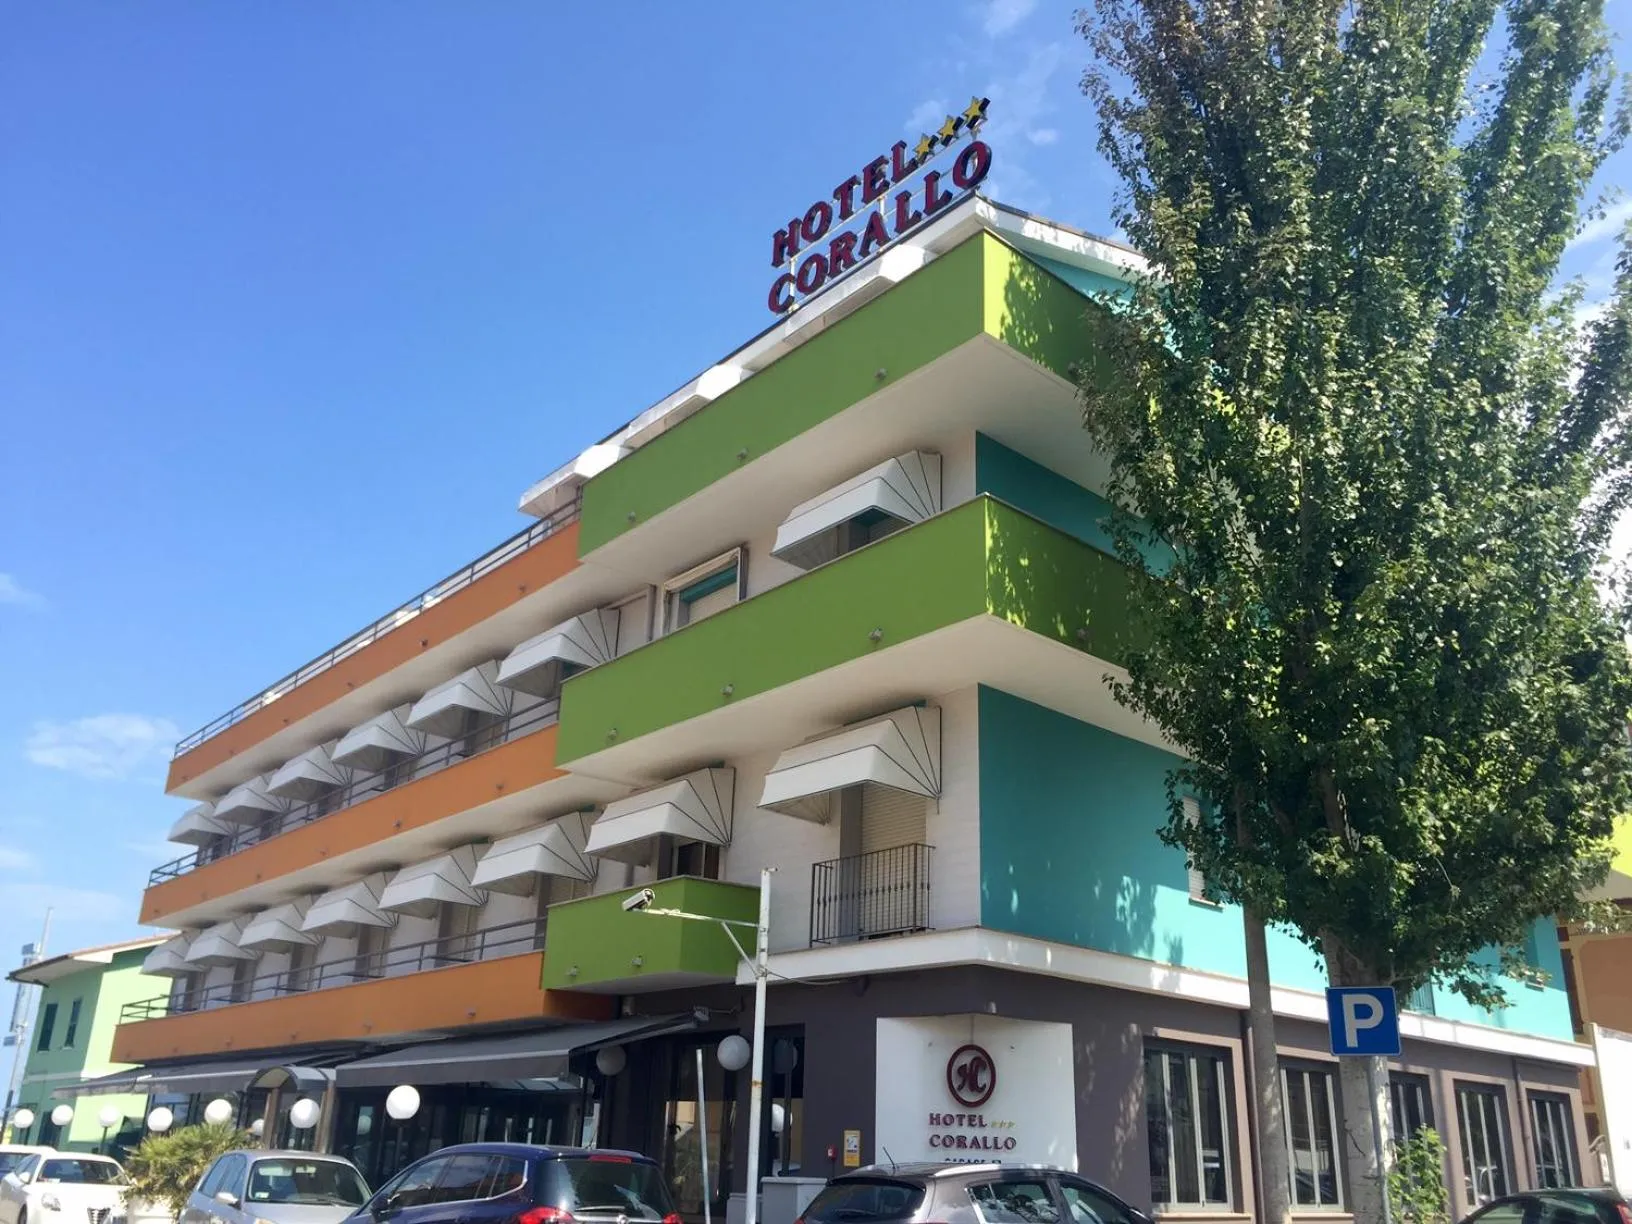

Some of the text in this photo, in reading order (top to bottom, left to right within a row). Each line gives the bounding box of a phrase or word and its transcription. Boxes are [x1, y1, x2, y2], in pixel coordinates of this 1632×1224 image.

[768, 141, 992, 314] CORALLO
[771, 140, 919, 268] HOTEL
[1342, 993, 1384, 1048] P
[929, 1112, 988, 1128] HOTEL
[929, 1134, 1017, 1151] CORALLO
